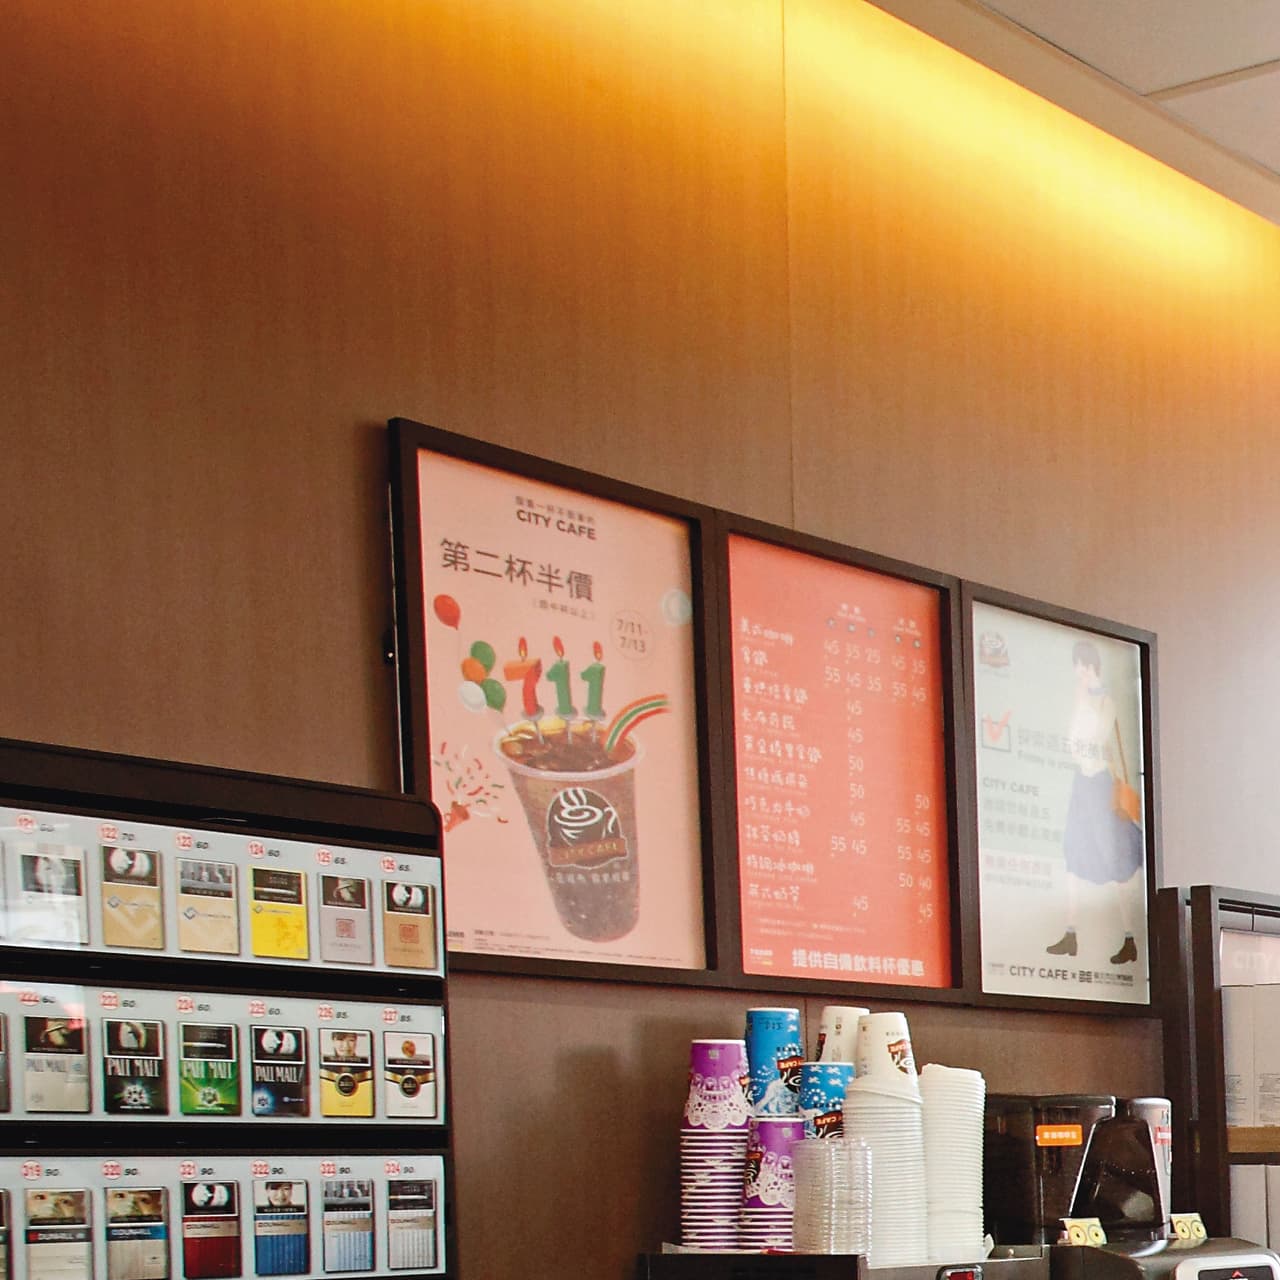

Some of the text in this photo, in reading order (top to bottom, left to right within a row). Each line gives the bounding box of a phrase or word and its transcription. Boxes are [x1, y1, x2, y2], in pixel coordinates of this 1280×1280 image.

[515, 509, 597, 540] CITY CAFE
[439, 537, 594, 602] 第二杯半價
[619, 636, 647, 653] 7/13
[982, 776, 1041, 797] CITY CAFE
[791, 947, 926, 977] 提供自備飲料杯優惠
[1009, 964, 1069, 981] CITY CAFE
[255, 1065, 299, 1084] PALL MALL
